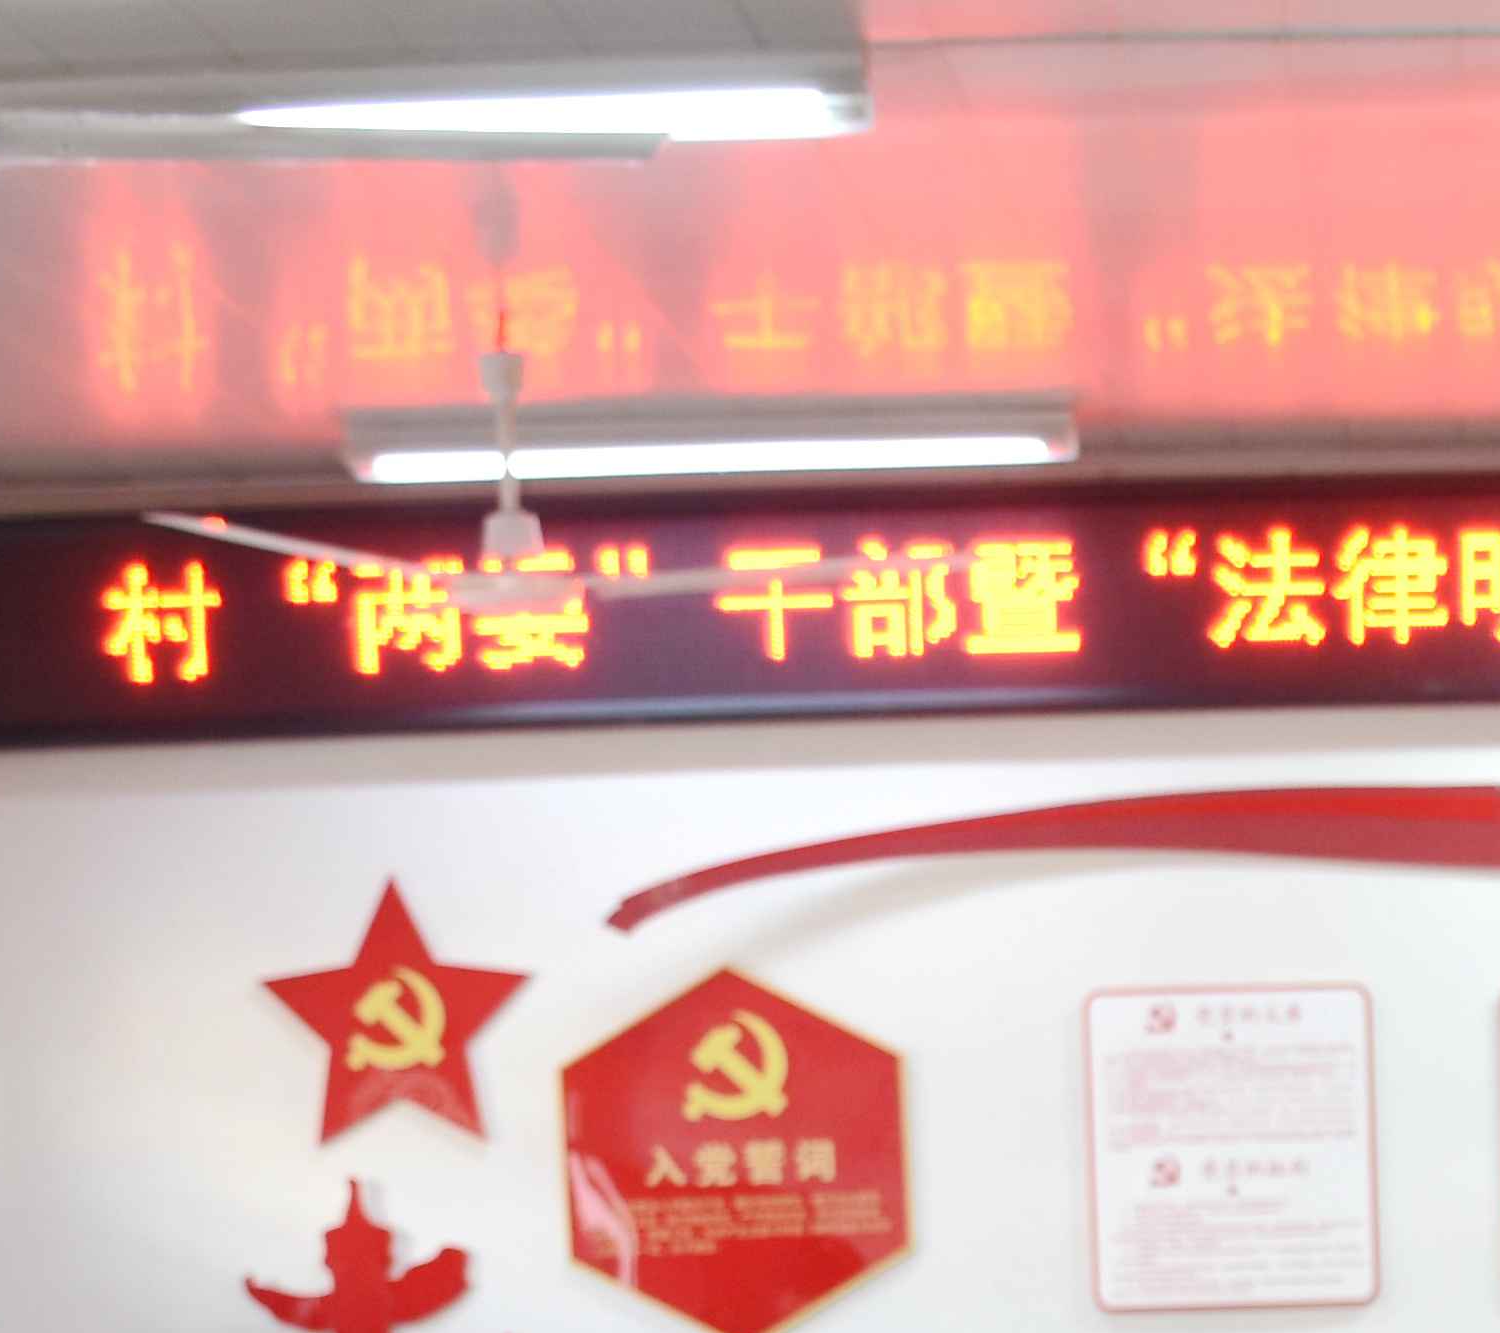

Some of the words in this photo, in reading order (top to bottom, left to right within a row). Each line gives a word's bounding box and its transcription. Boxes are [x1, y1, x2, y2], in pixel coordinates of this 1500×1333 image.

[100, 560, 222, 684] 村
[712, 532, 1084, 662] 干部暨
